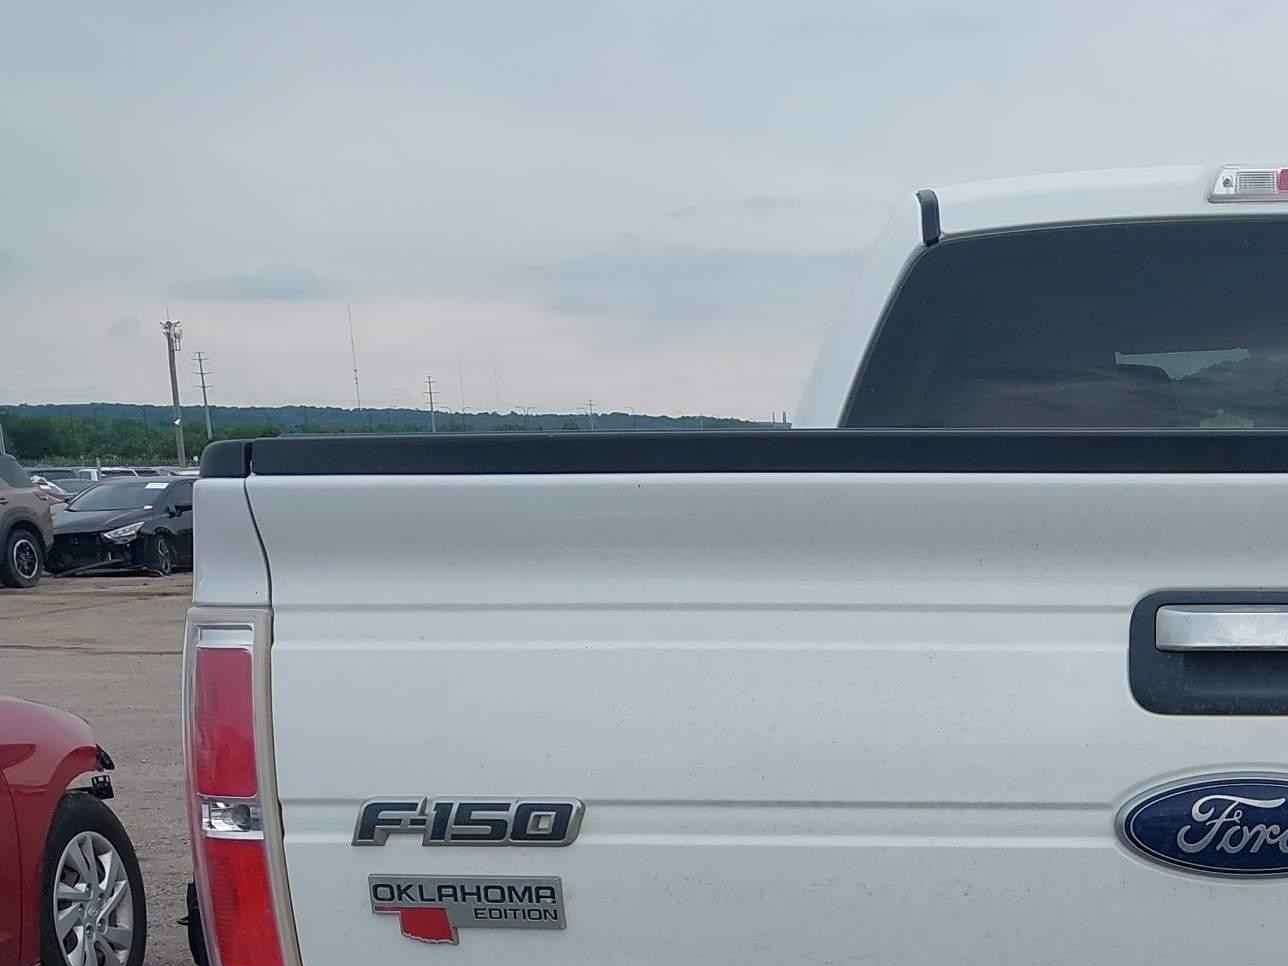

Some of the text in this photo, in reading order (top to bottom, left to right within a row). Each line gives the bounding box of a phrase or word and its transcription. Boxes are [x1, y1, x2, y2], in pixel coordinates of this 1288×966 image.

[352, 796, 586, 847] F-150
[372, 883, 557, 904] OKLAHOMA
[473, 907, 559, 921] EDITION
